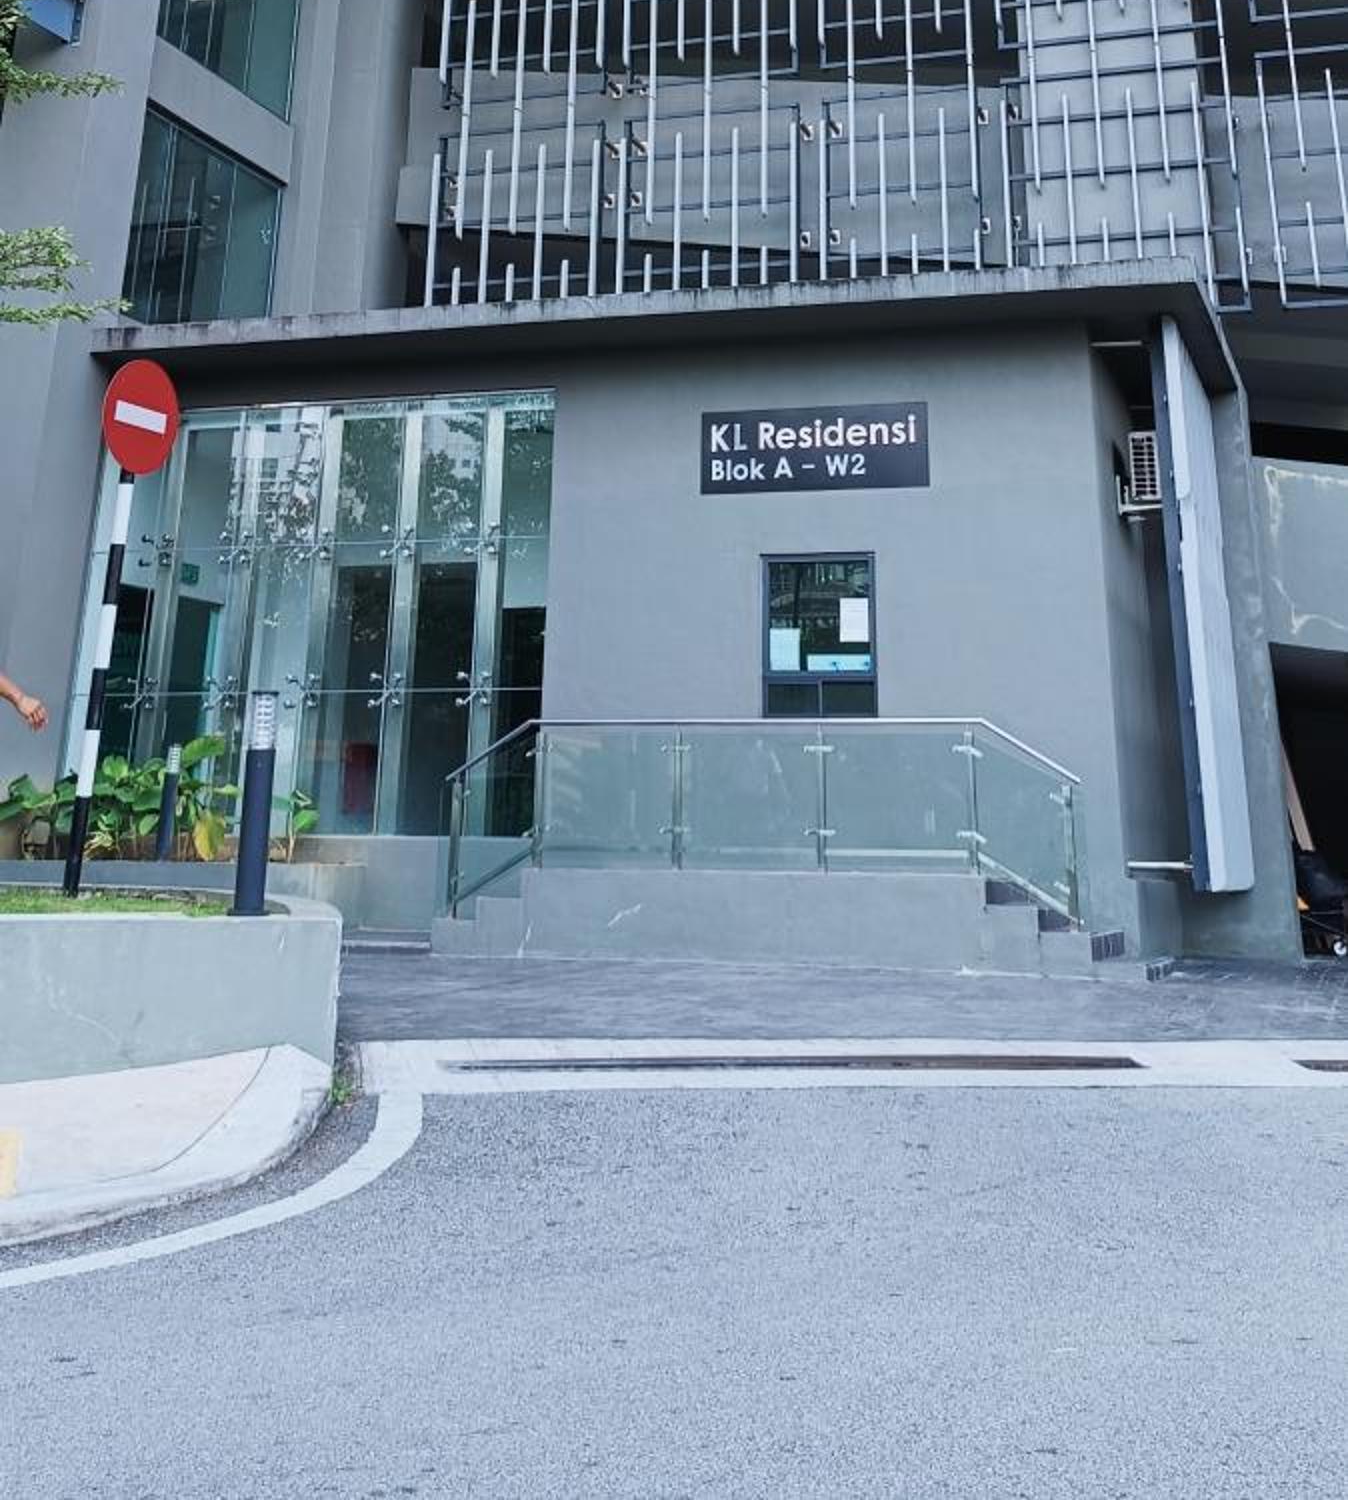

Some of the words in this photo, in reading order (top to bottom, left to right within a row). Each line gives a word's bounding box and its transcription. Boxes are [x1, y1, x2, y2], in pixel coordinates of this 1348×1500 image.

[710, 424, 748, 452] KL
[758, 414, 916, 450] Residensi
[710, 457, 766, 481] Blok
[774, 456, 794, 479] A
[825, 453, 867, 477] W2
